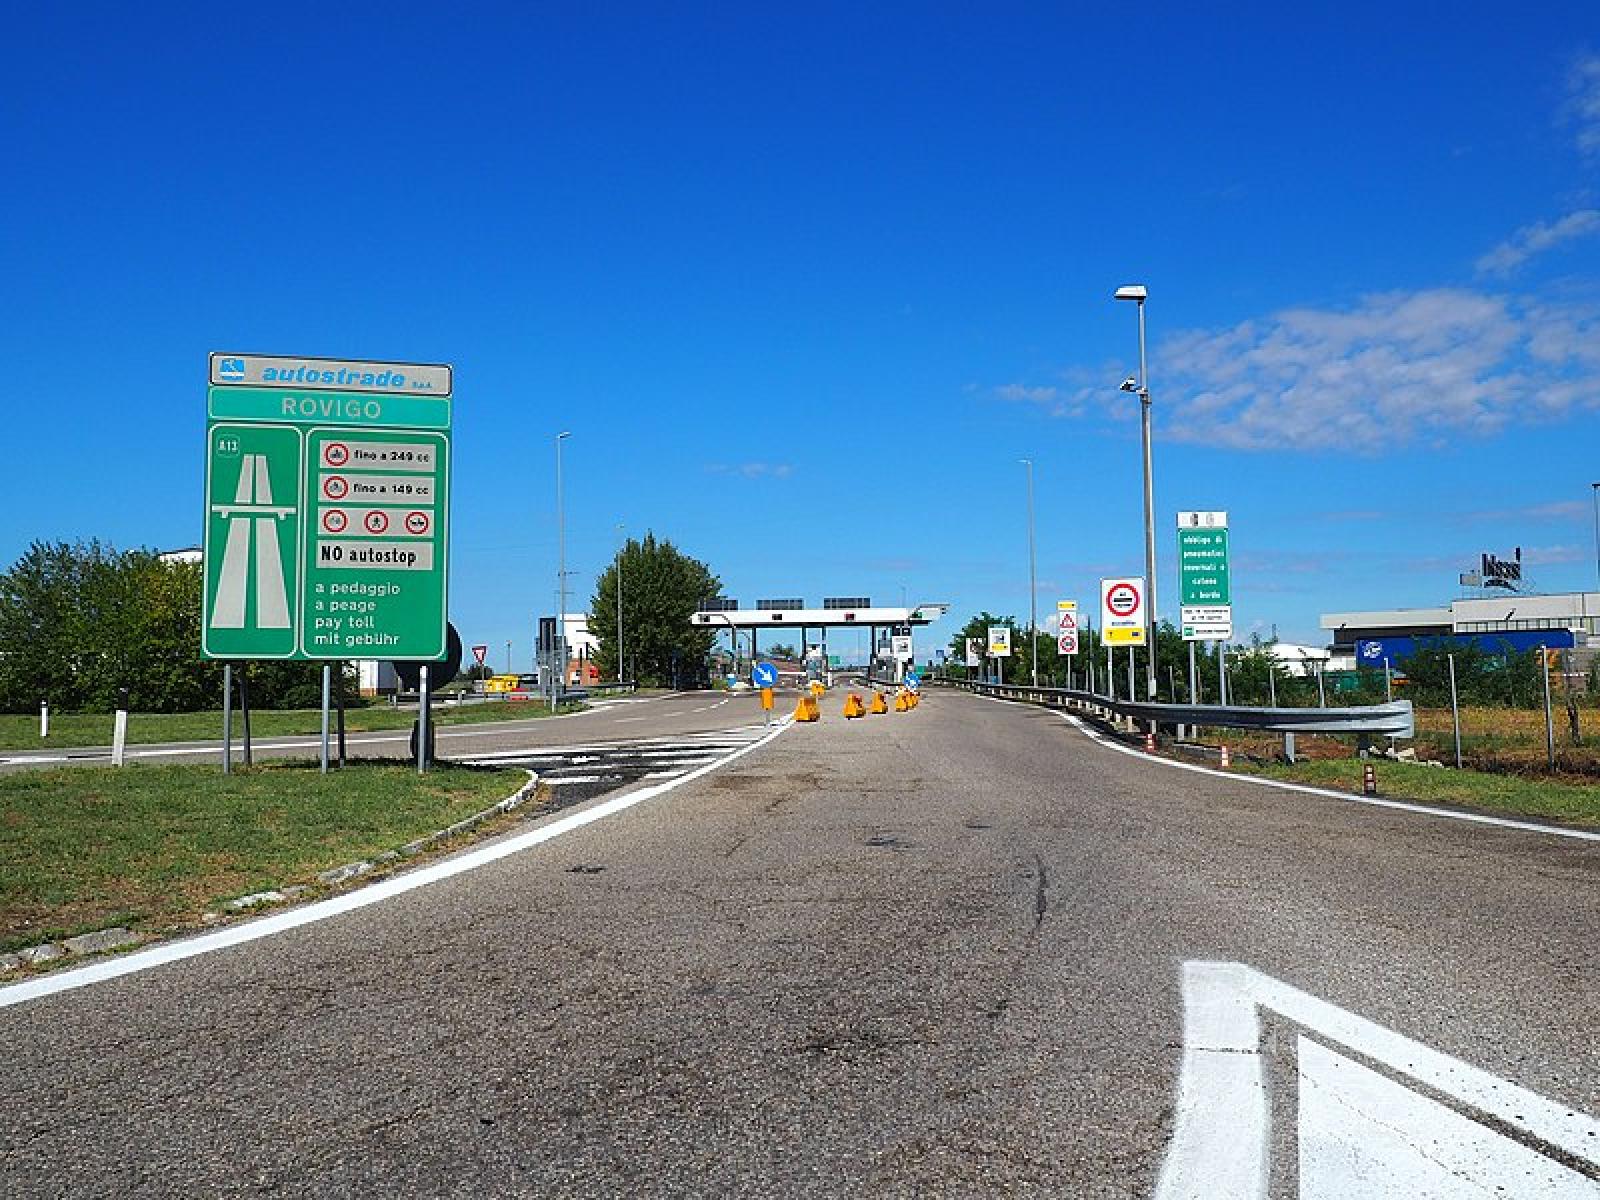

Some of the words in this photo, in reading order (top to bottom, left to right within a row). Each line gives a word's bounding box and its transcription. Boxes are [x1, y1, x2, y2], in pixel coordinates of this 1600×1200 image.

[262, 365, 406, 387] autostrade
[281, 397, 381, 419] ROVIGO
[219, 439, 237, 452] A13
[353, 449, 377, 460] fino
[390, 451, 413, 461] 249
[416, 454, 430, 462] cc
[353, 483, 377, 493] fino
[379, 485, 387, 493] a
[392, 483, 413, 494] 149
[415, 487, 429, 495] cc
[321, 545, 343, 561] NO
[349, 547, 417, 567] autostop
[315, 583, 325, 593] a
[329, 581, 401, 597] pedaggio
[315, 617, 343, 630] pay
[349, 615, 375, 629] toll
[314, 632, 340, 645] mit
[345, 633, 401, 648] gebühr
